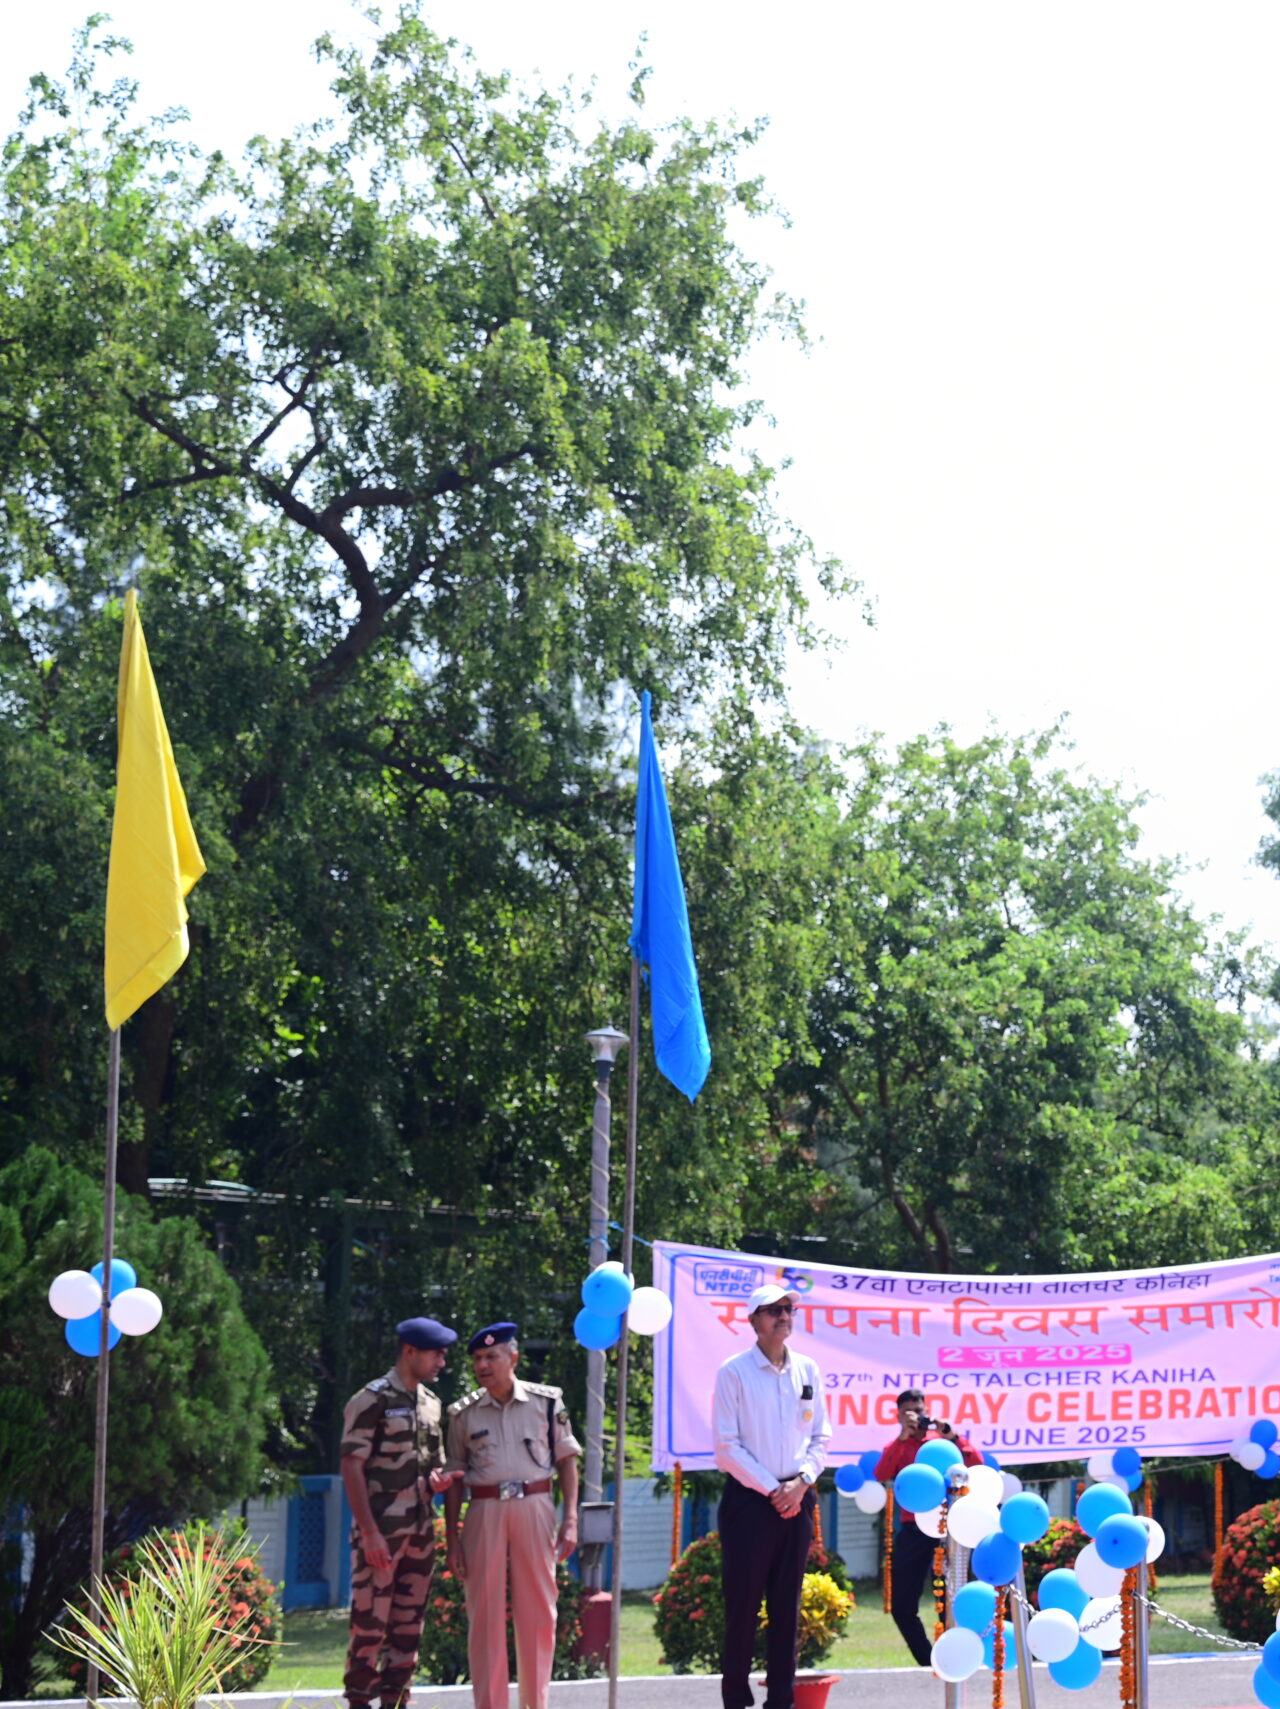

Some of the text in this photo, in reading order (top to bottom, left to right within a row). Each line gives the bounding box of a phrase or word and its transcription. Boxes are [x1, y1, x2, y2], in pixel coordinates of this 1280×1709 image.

[705, 1281, 754, 1293] NTPC
[944, 1296, 1109, 1343] दिवस
[943, 1344, 1128, 1369] 2 जून 2025
[883, 1373, 960, 1389] NTPC
[970, 1370, 1102, 1388] TALCHER
[1112, 1367, 1216, 1384] KANIHA
[924, 1393, 1009, 1425] DAY
[981, 1427, 1066, 1447] JUNE
[1078, 1425, 1147, 1444] 2025
